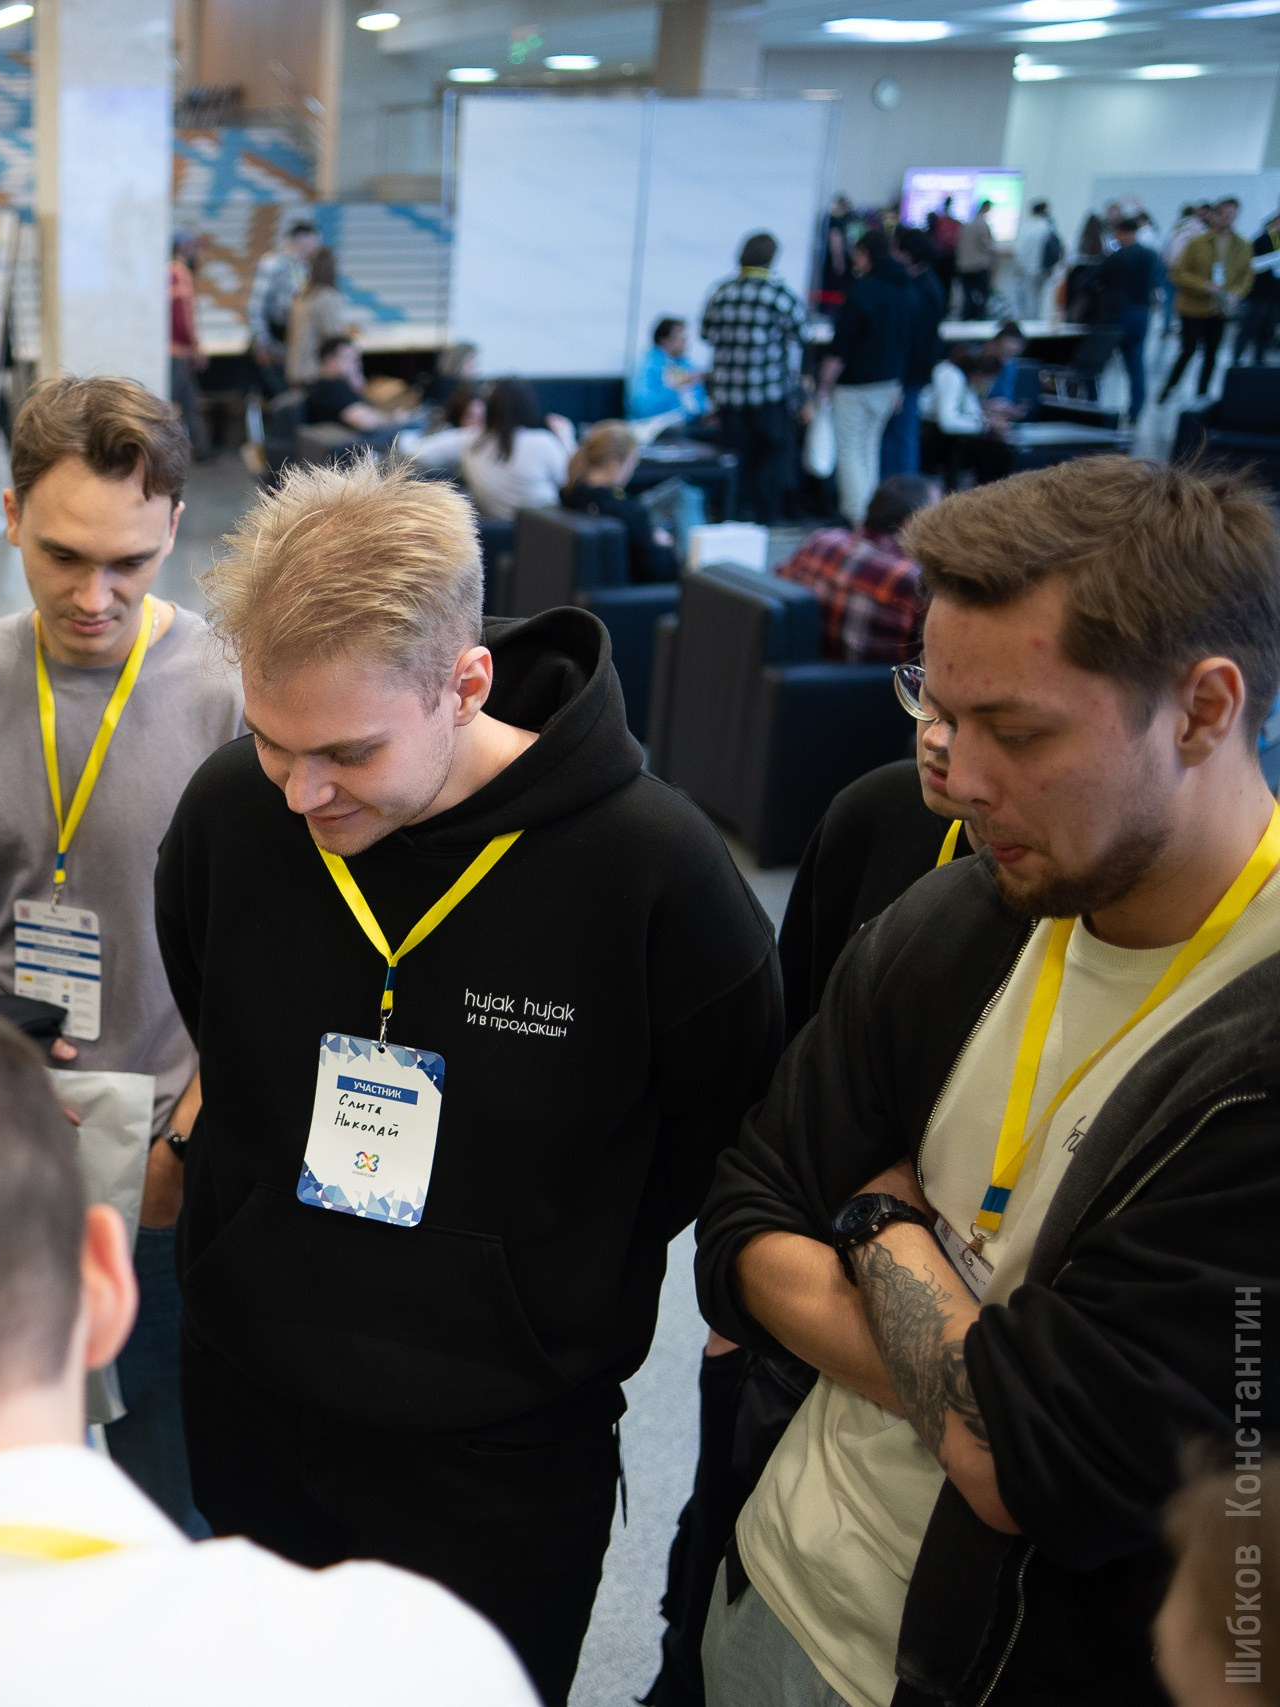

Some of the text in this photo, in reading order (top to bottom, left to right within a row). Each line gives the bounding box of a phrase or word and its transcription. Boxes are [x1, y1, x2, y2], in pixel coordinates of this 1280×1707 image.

[464, 988, 576, 1022] hujak hujak
[466, 1012, 567, 1038] и в продакшн
[353, 1081, 402, 1099] УЧАСТНИК
